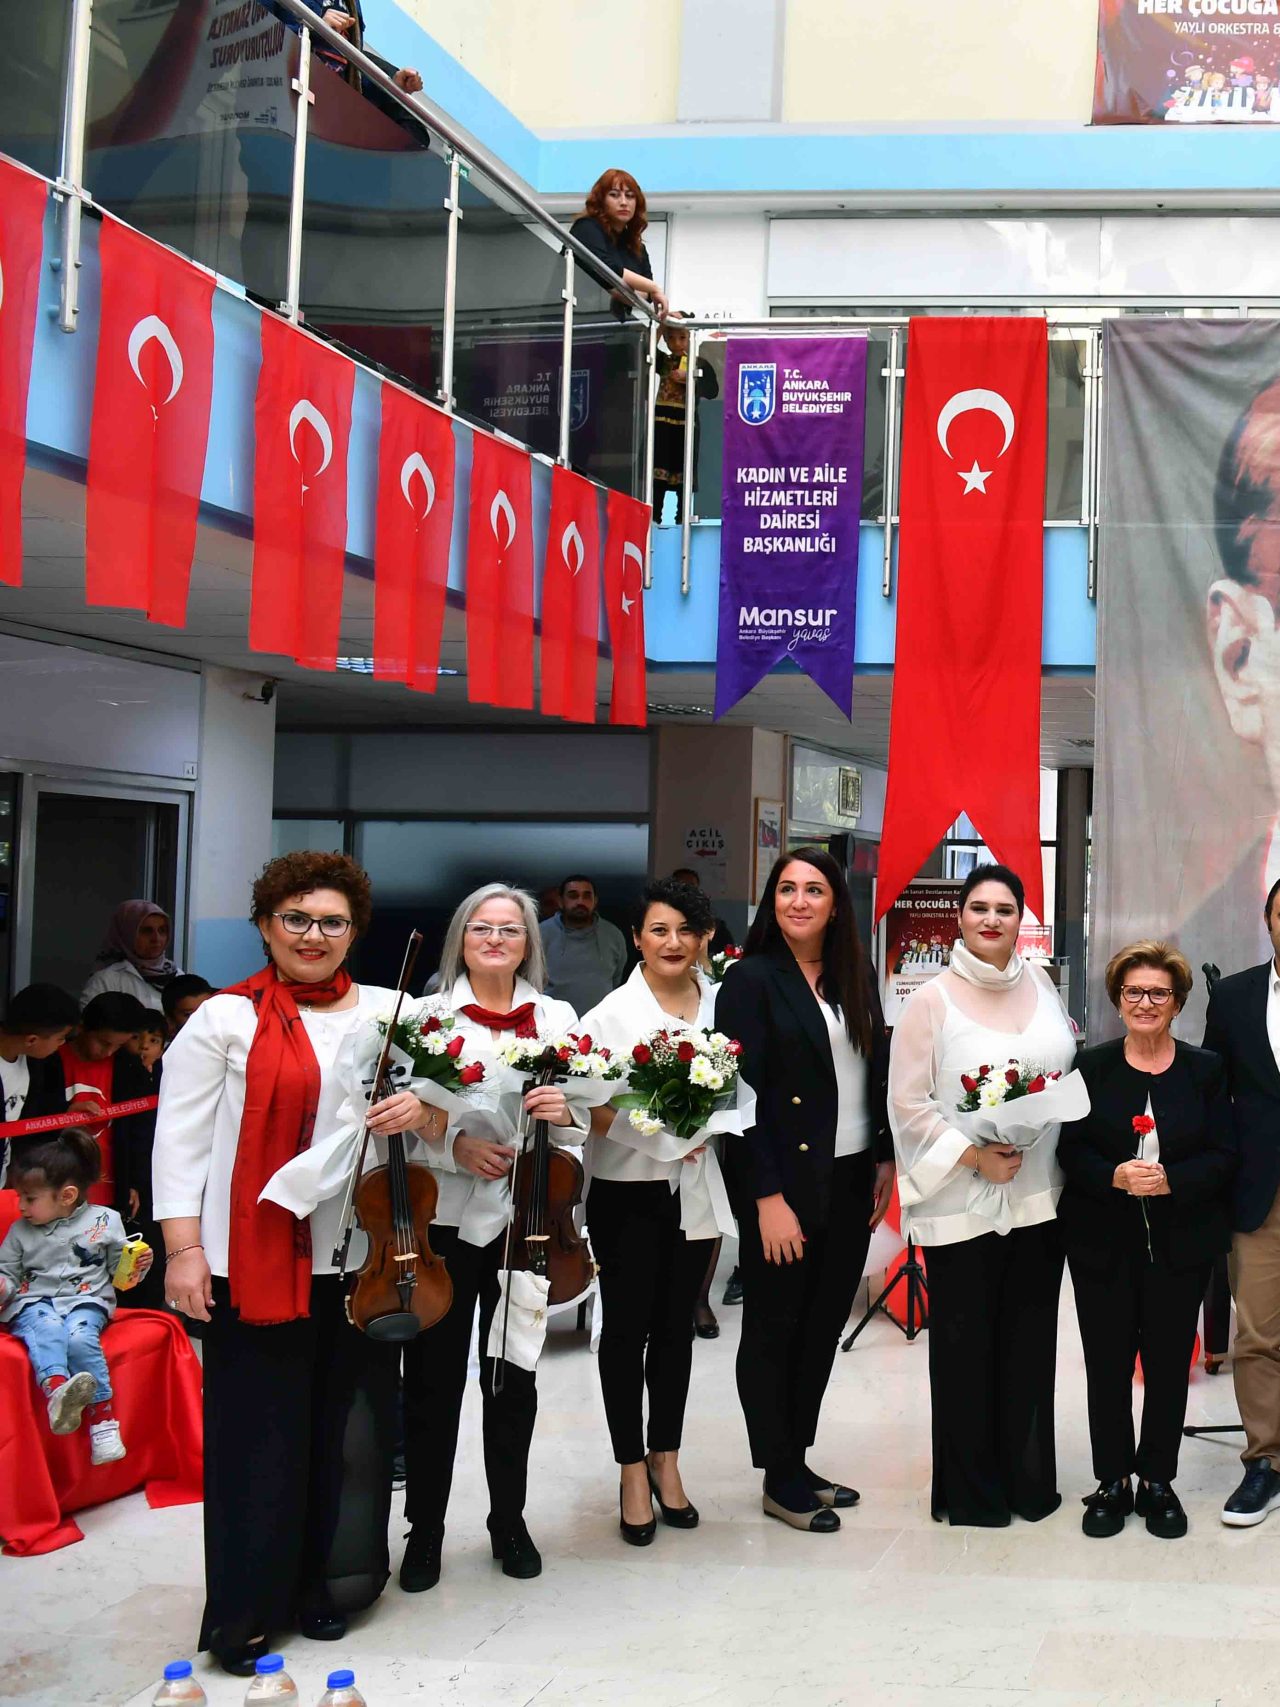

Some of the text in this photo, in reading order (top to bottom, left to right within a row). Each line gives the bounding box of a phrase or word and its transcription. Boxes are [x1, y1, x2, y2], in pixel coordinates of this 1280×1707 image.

[1137, 0, 1183, 14] HER
[1174, 21, 1205, 34] YAYLI
[1208, 22, 1270, 35] ORKESTRA
[783, 369, 803, 379] T.C.
[782, 380, 830, 390] ANKARA
[736, 463, 848, 484] KADIN VE AİLE
[744, 486, 838, 506] HİZMETLERİ
[760, 509, 820, 529] DAİRESİ
[743, 533, 836, 554] BAŞKANLIĞI
[738, 606, 838, 626] Mansur
[894, 900, 913, 909] HER
[914, 898, 951, 910] ÇOCUĞA
[895, 988, 911, 996] 100
[25, 1117, 60, 1131] ANKARA
